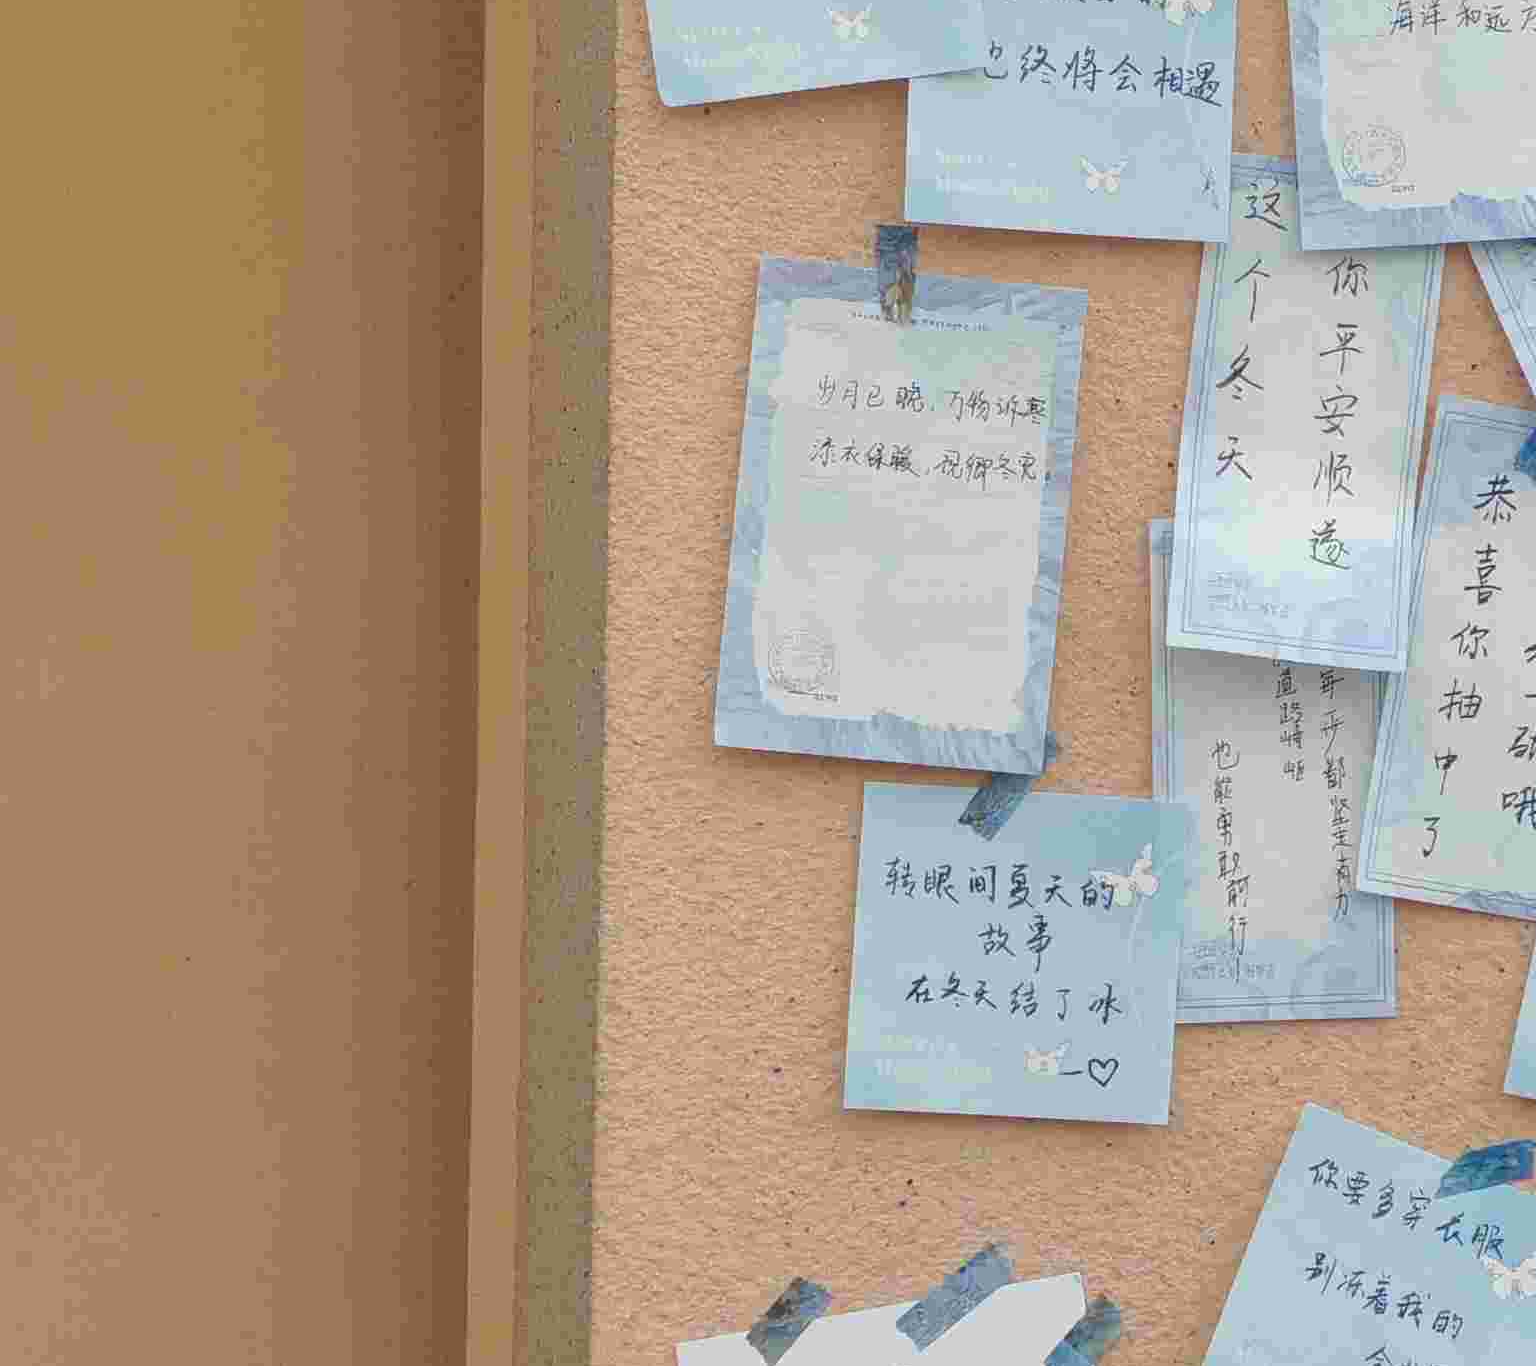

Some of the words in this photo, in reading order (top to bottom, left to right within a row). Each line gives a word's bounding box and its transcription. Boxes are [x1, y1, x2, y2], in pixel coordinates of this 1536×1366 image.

[1214, 175, 1289, 481] 这个冬天
[1309, 255, 1371, 572] 你平安顺遂
[1418, 474, 1520, 859] 恭喜你抽中了
[884, 856, 1116, 911] 转眼间夏天的
[977, 913, 1053, 974] 故事
[905, 970, 1124, 1027] 在冬天结了冰
[1308, 1156, 1505, 1260] 你要多穿衣服
[1305, 1251, 1465, 1340] 别冻着我的
